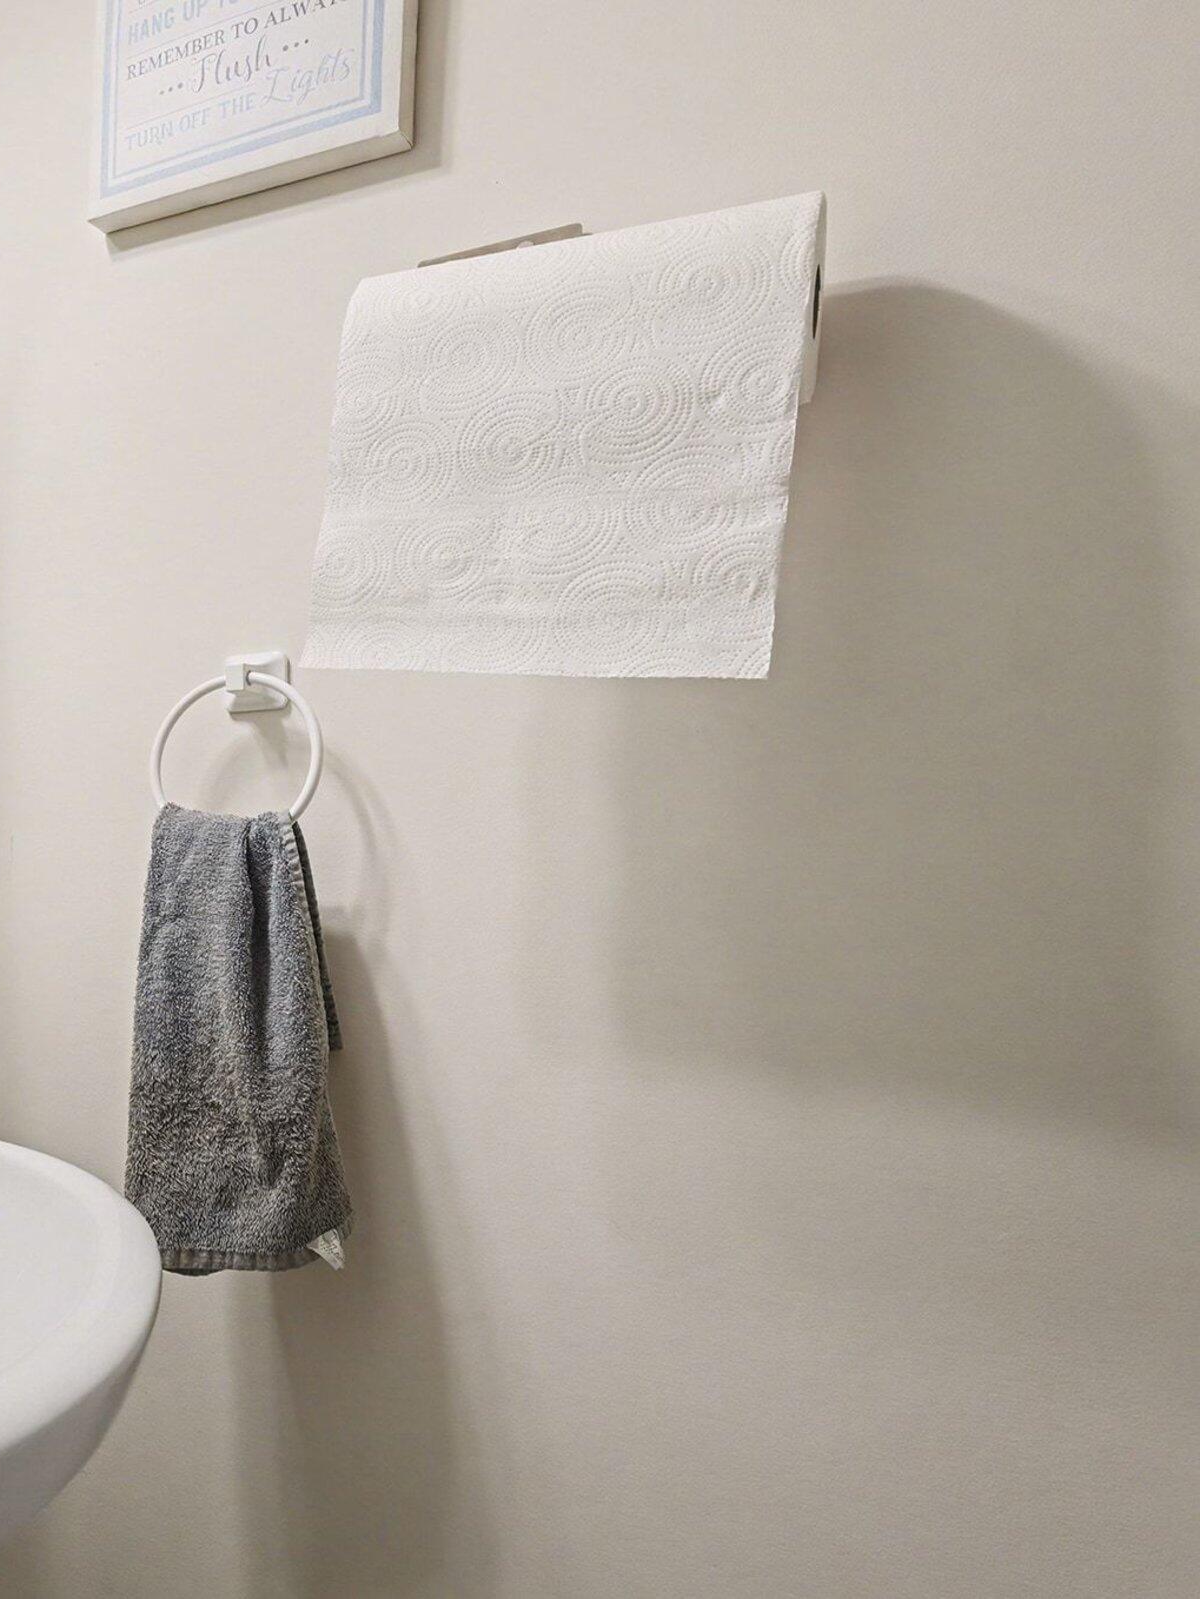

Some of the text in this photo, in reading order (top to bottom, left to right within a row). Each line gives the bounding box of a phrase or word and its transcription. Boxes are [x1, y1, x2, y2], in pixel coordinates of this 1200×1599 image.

[126, 0, 346, 81] REMEMBER TO ALWA
[128, 0, 208, 45] HANG UP
[192, 33, 272, 94] Flush
[125, 47, 355, 152] TURN OFF THE Lights
